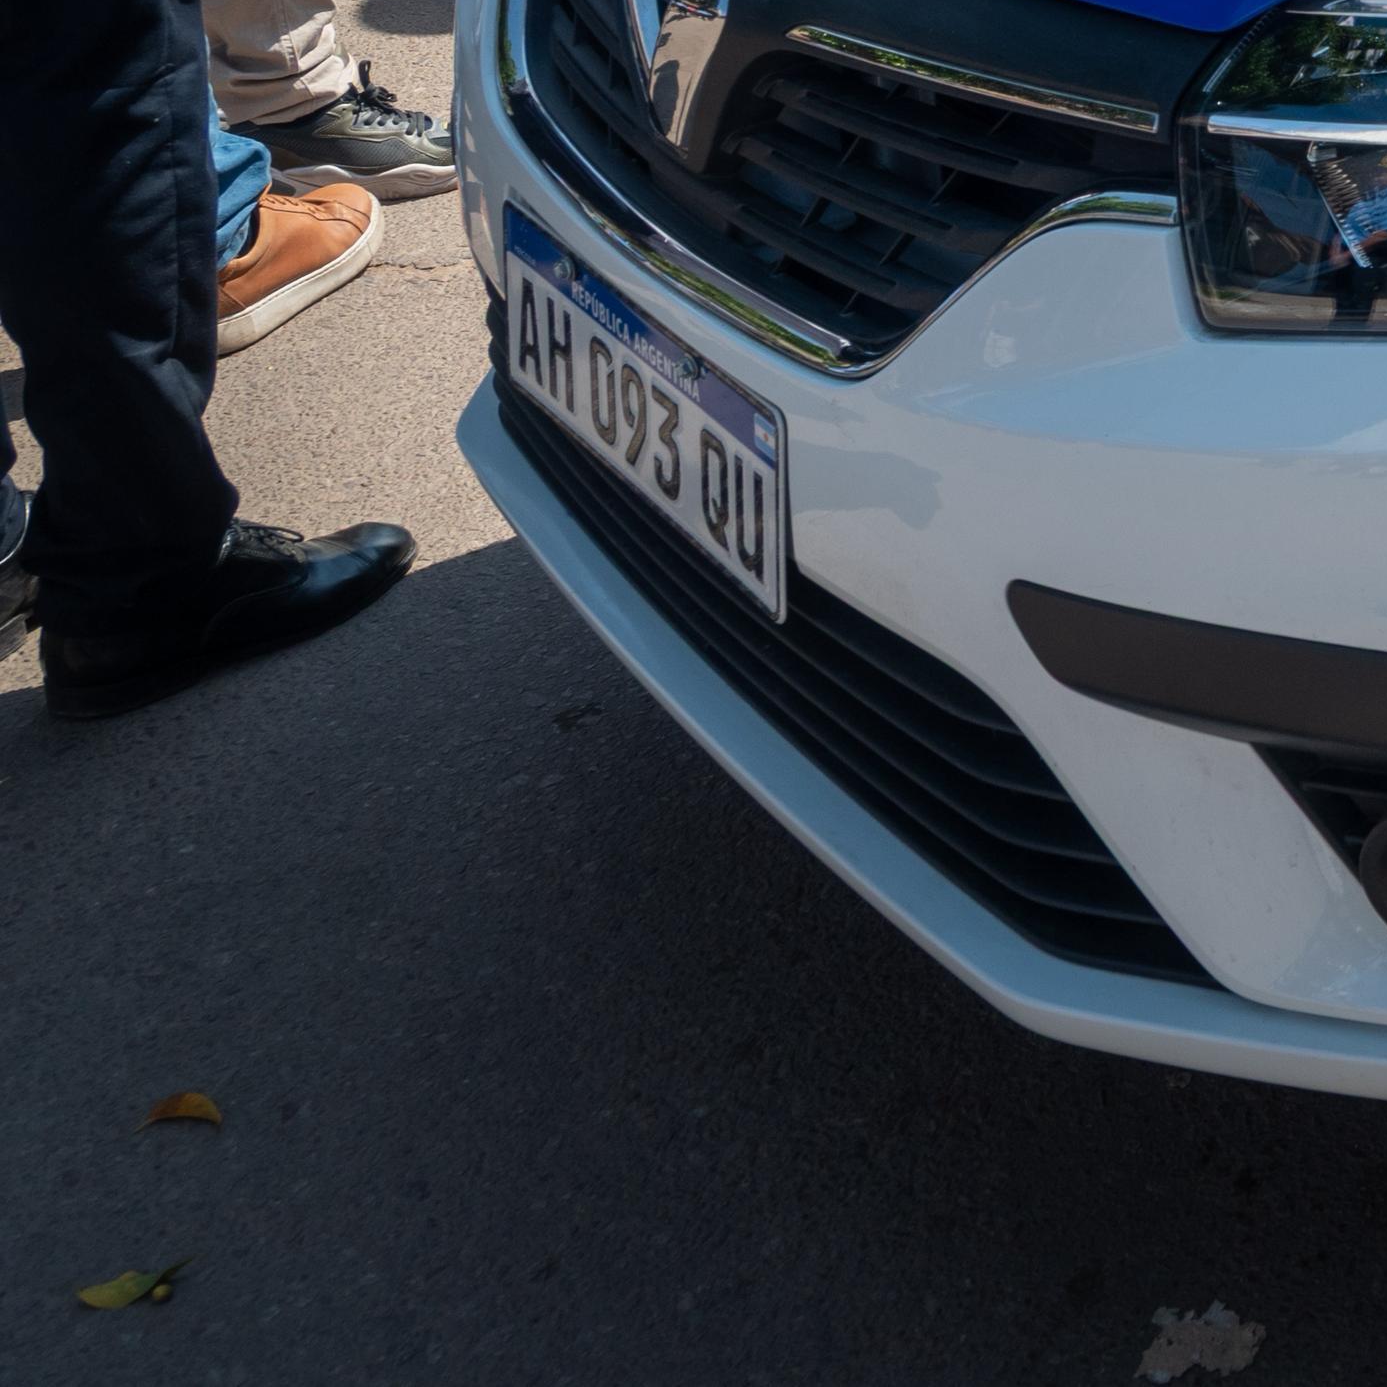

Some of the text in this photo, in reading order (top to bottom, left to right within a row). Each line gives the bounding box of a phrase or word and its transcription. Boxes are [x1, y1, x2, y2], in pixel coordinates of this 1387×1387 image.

[572, 280, 630, 346] REPÚBLICA
[520, 277, 765, 585] AH 093 QU
